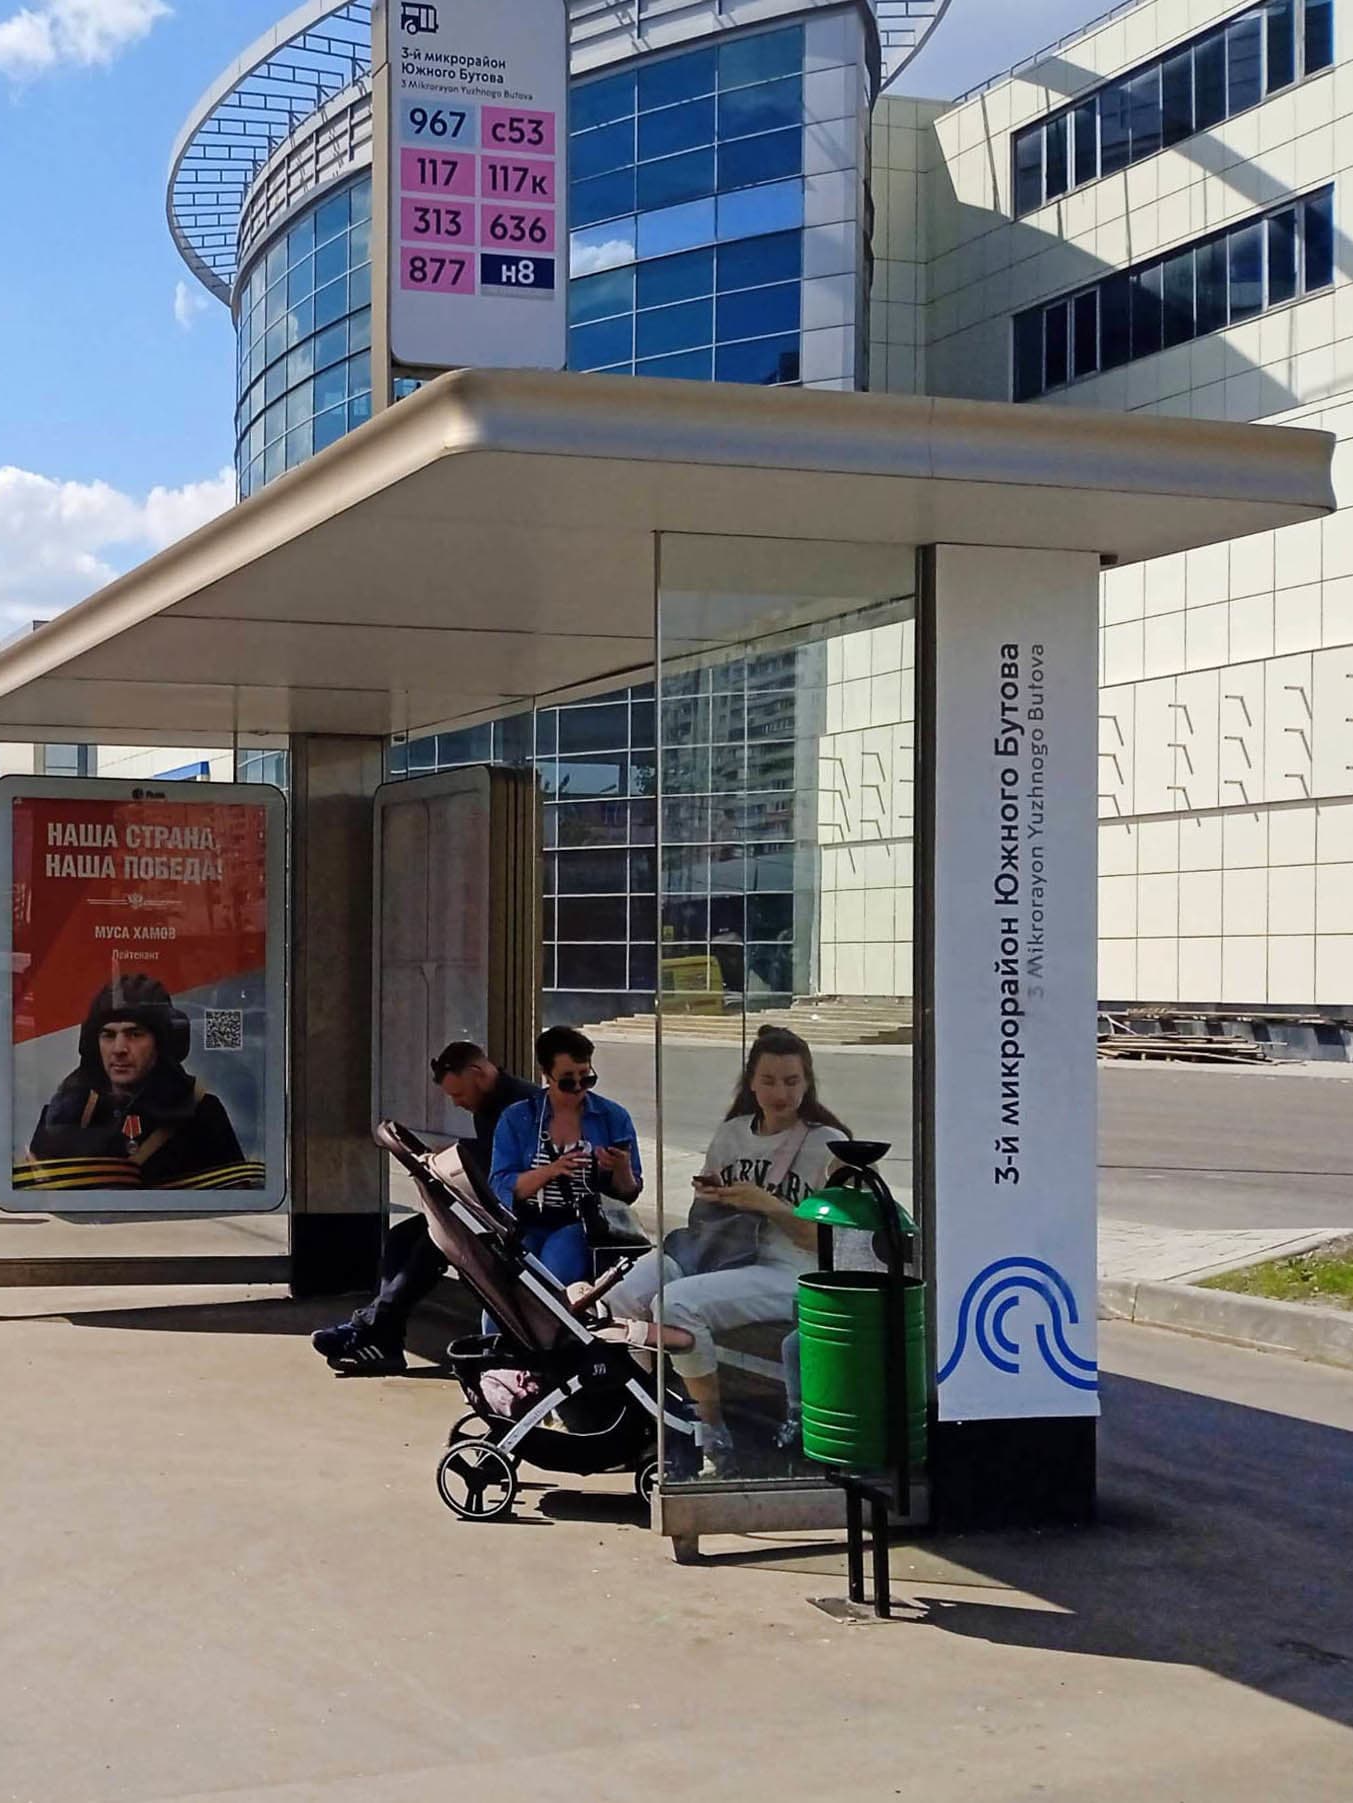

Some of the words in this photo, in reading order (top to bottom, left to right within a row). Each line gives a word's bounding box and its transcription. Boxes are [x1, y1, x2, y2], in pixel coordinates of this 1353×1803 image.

[401, 47, 421, 60] 3-й
[424, 52, 506, 69] микрорайон
[401, 62, 456, 79] Южного
[459, 68, 504, 83] Бутова
[401, 79, 407, 88] 3
[408, 81, 459, 94] Mikrorayon
[461, 86, 502, 99] Yuzhnogo
[503, 90, 533, 100] Butova
[409, 107, 466, 138] 967
[417, 158, 458, 187] 117
[413, 206, 462, 237] 313
[490, 214, 547, 244] 636
[409, 256, 466, 286] 877
[1027, 643, 1045, 721] Butova
[994, 643, 1024, 756] Бутова
[1027, 732, 1048, 839] Yuzhnogo
[48, 822, 118, 847] НАША
[994, 797, 1019, 906] Южного
[46, 854, 116, 879] НАША
[123, 855, 223, 884] ПОБЕДА!
[1027, 846, 1048, 978] Mikrorayon
[95, 925, 130, 939] МУСА
[133, 927, 177, 940] ХАМОВ
[1028, 987, 1044, 998] 3
[994, 916, 1025, 1126] микрорайон
[995, 1136, 1019, 1185] 3-й
